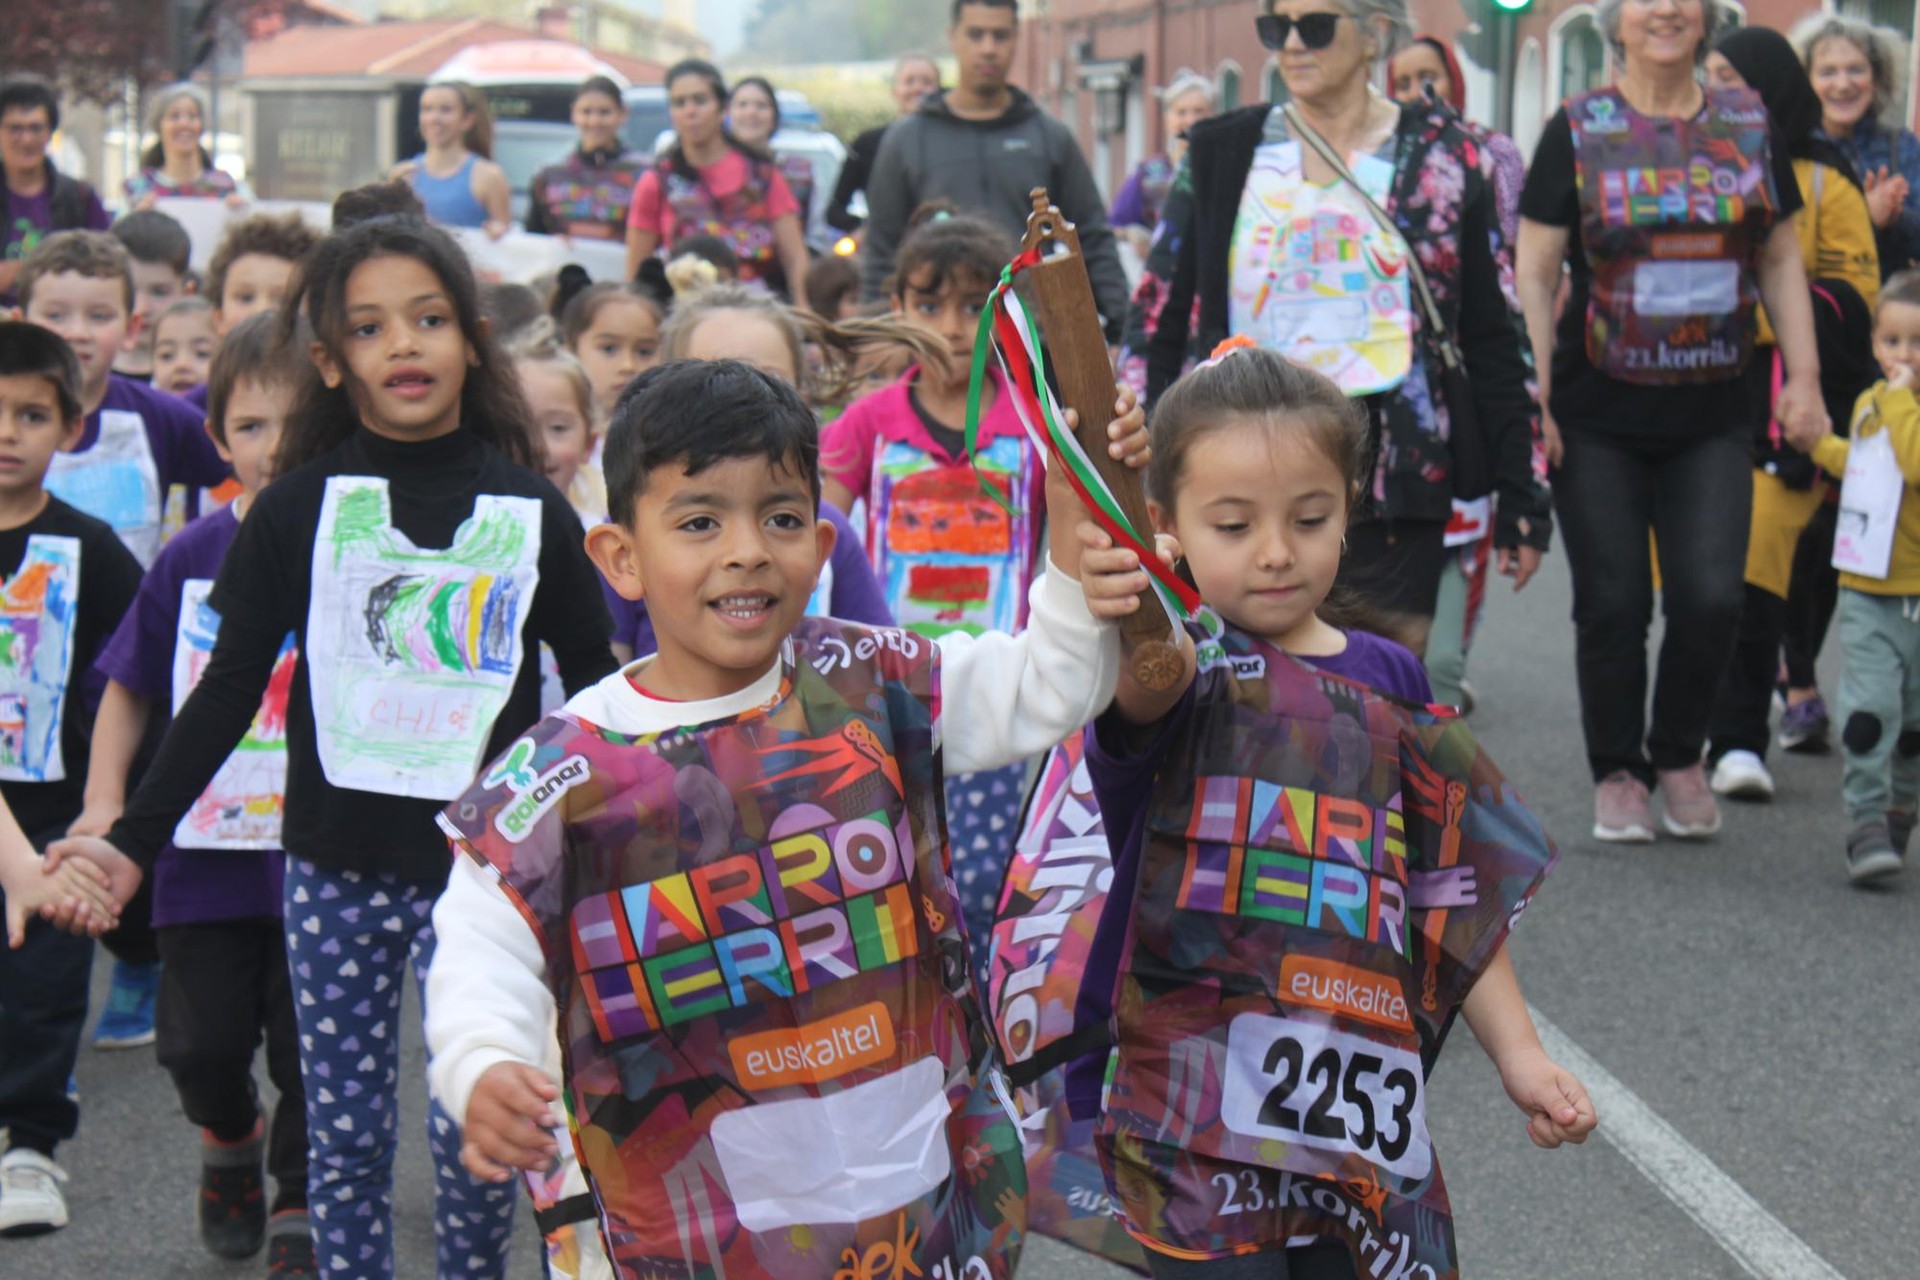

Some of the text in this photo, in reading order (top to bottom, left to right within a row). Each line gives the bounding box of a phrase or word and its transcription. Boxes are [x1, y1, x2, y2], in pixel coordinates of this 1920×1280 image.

[855, 628, 919, 660] eitb
[504, 761, 583, 834] goiener
[1185, 776, 1408, 888] HARR
[570, 815, 902, 973] HARRO
[1175, 841, 1412, 966] HERR
[579, 882, 919, 1043] HERRI
[745, 1013, 881, 1076] euskaltel
[1256, 1036, 1417, 1162] 2253
